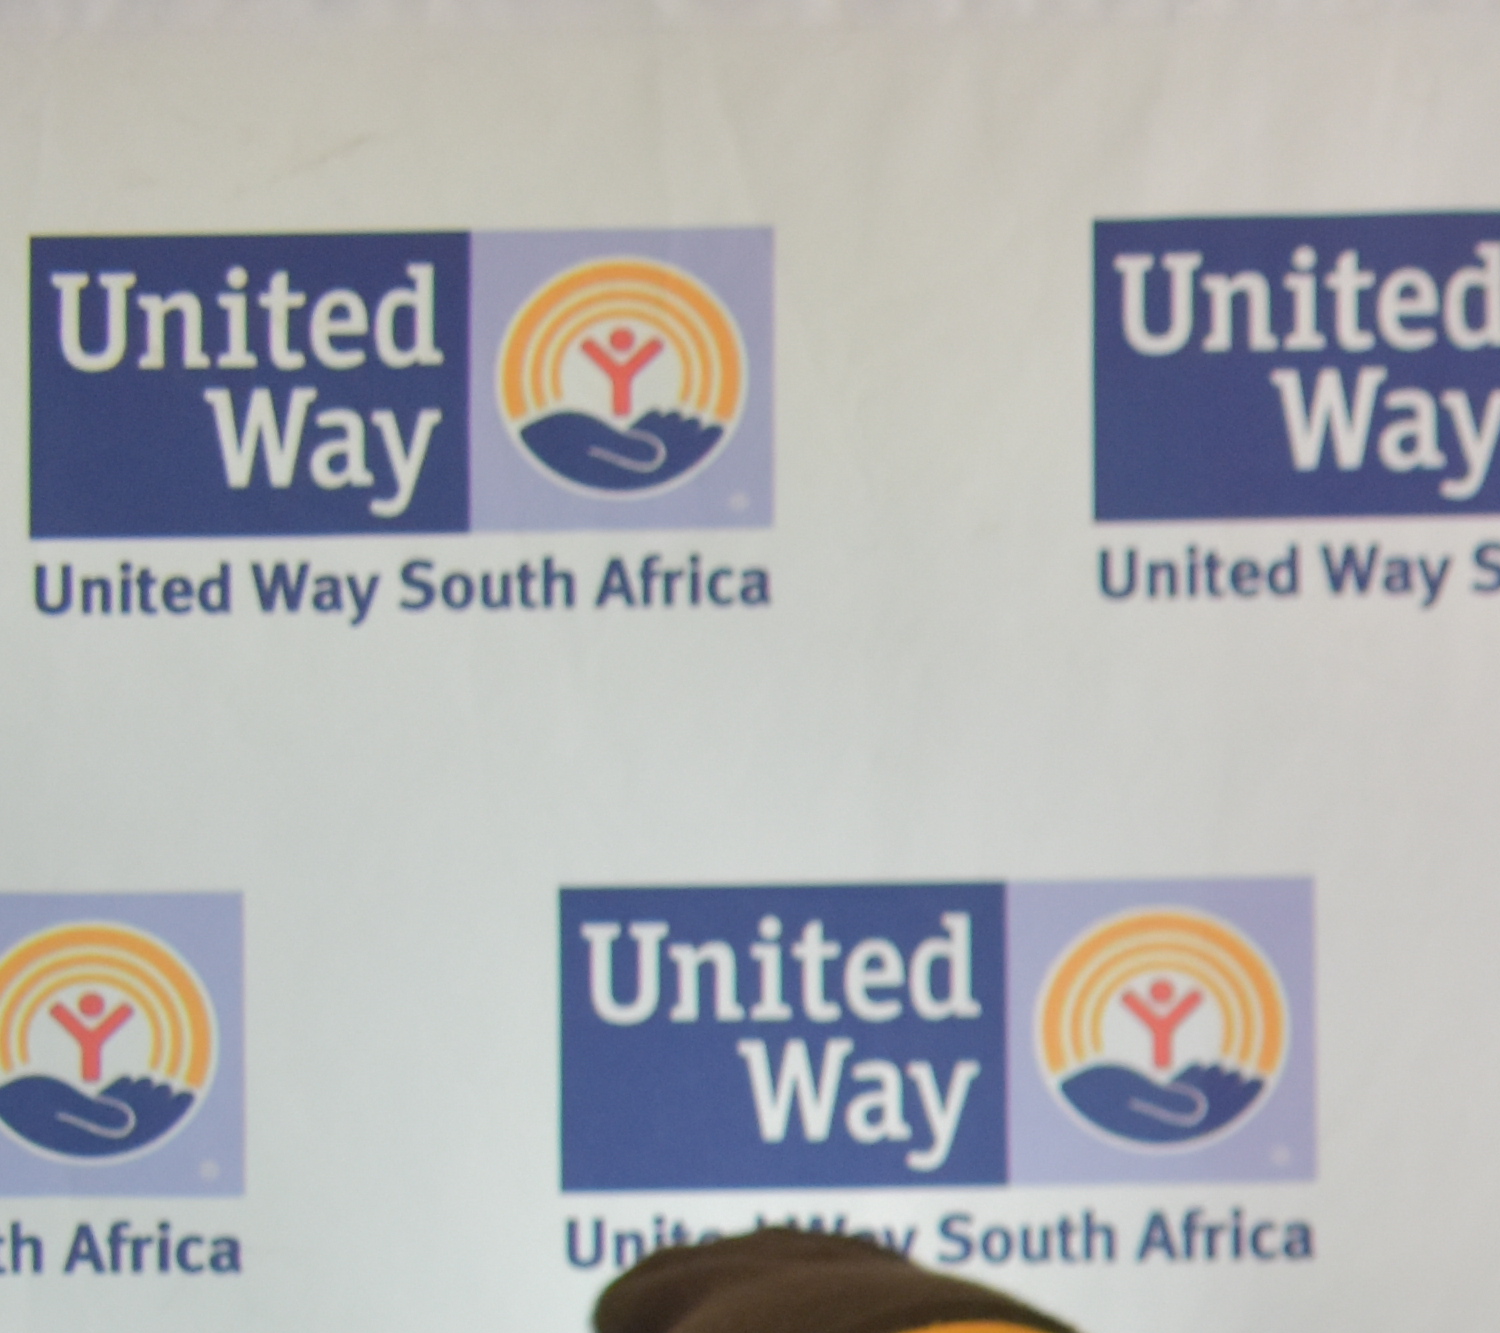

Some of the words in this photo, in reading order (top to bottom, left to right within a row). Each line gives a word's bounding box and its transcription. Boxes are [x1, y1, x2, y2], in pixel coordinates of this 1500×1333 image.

[50, 263, 444, 371] United
[205, 387, 442, 518] Way
[31, 561, 232, 618] United
[250, 561, 381, 625] Way
[398, 558, 577, 610] South
[596, 552, 772, 608] Africa
[1097, 543, 1300, 600] United
[1321, 543, 1452, 606] Way
[580, 913, 982, 1026] United
[738, 1039, 981, 1172] Way
[64, 1217, 243, 1275] Africa
[936, 1213, 1116, 1265] South
[1137, 1207, 1316, 1262] Africa
